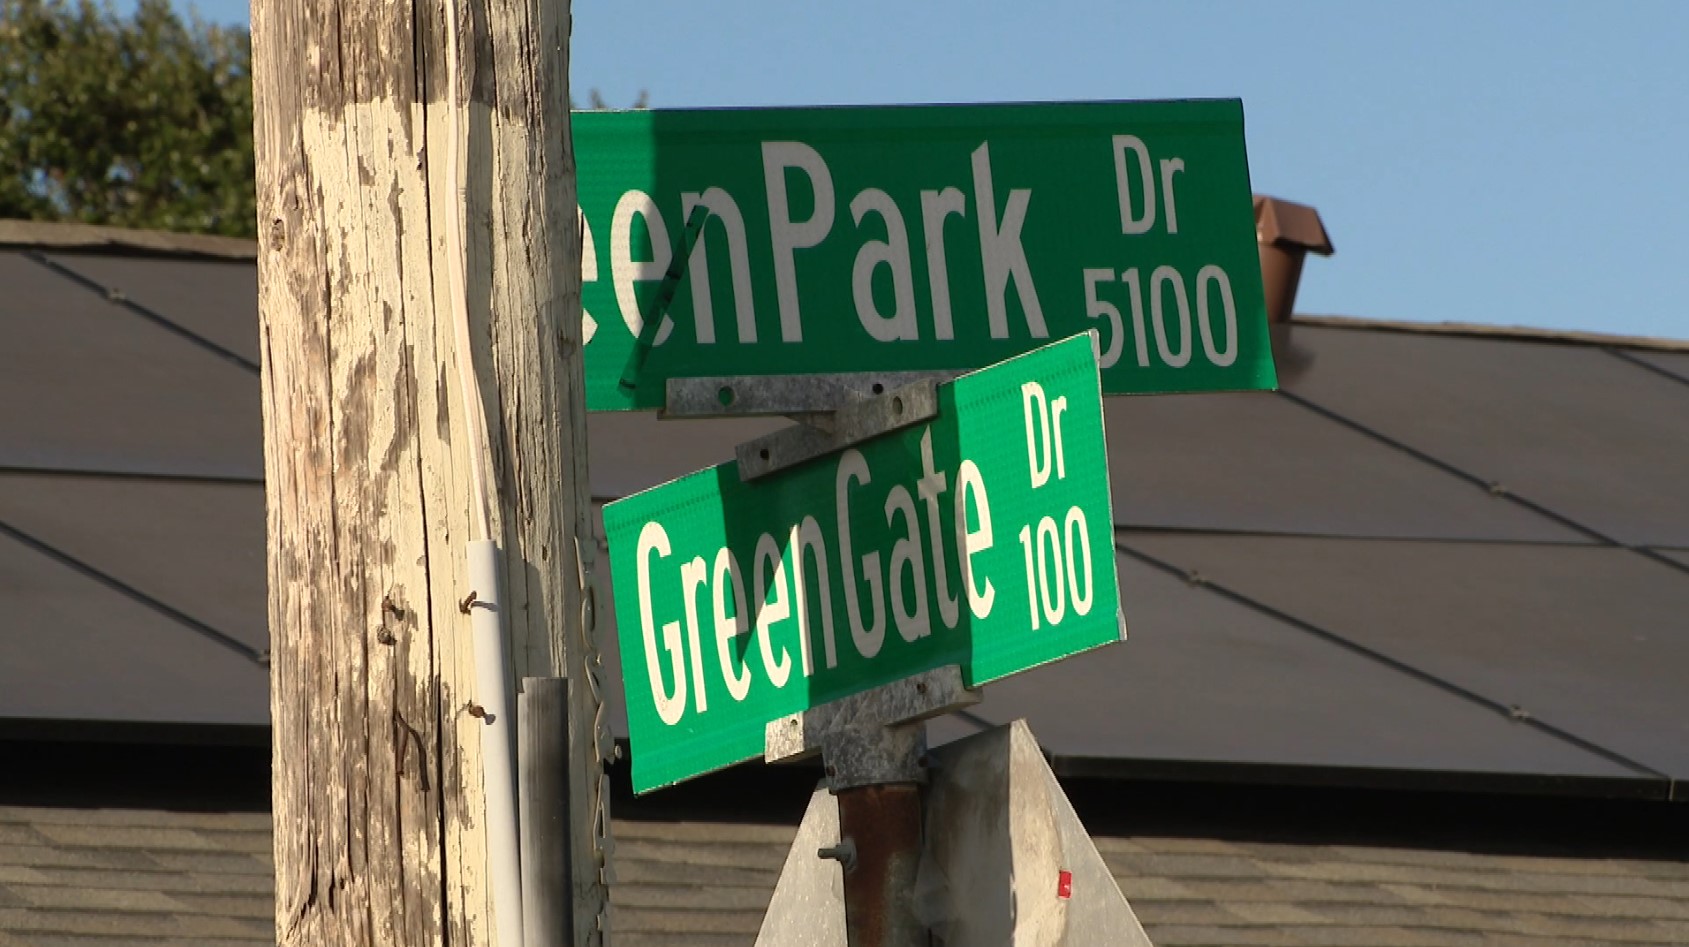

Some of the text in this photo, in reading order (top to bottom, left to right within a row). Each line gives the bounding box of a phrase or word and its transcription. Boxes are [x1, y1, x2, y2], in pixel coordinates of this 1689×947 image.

[577, 134, 1185, 348] enPark Dr
[1083, 265, 1238, 369] 5100
[636, 381, 1067, 726] GreenGate Dr
[1018, 505, 1093, 631] 100
